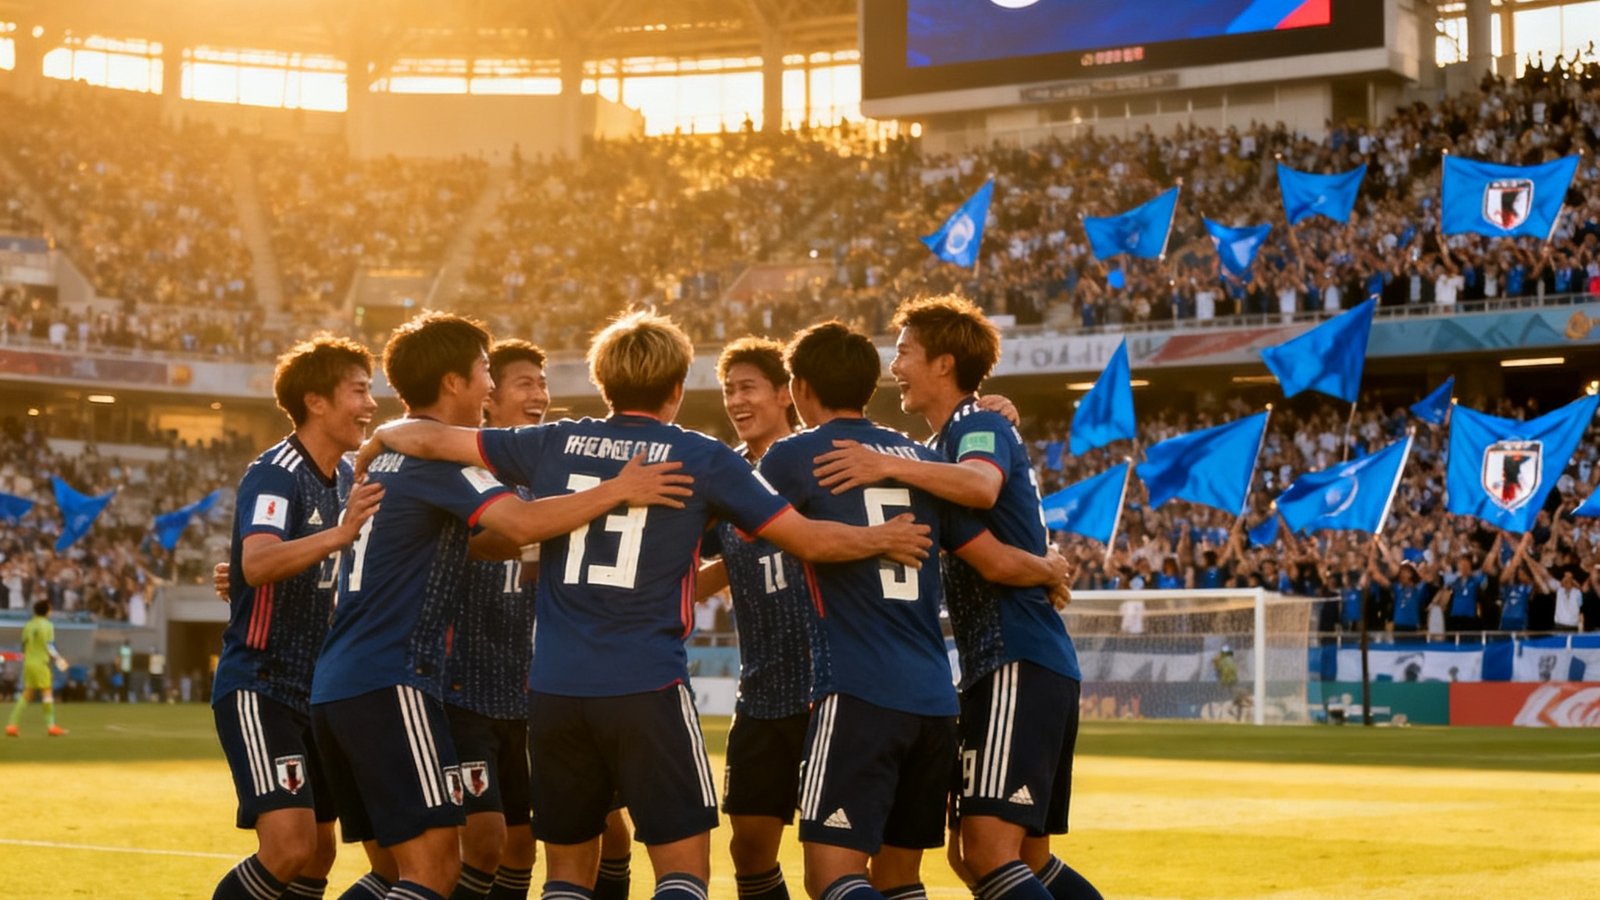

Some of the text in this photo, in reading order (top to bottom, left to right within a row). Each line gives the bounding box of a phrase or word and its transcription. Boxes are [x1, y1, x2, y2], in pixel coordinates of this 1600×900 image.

[563, 473, 648, 589] 13
[863, 487, 919, 600] 5
[962, 750, 977, 797] 9
